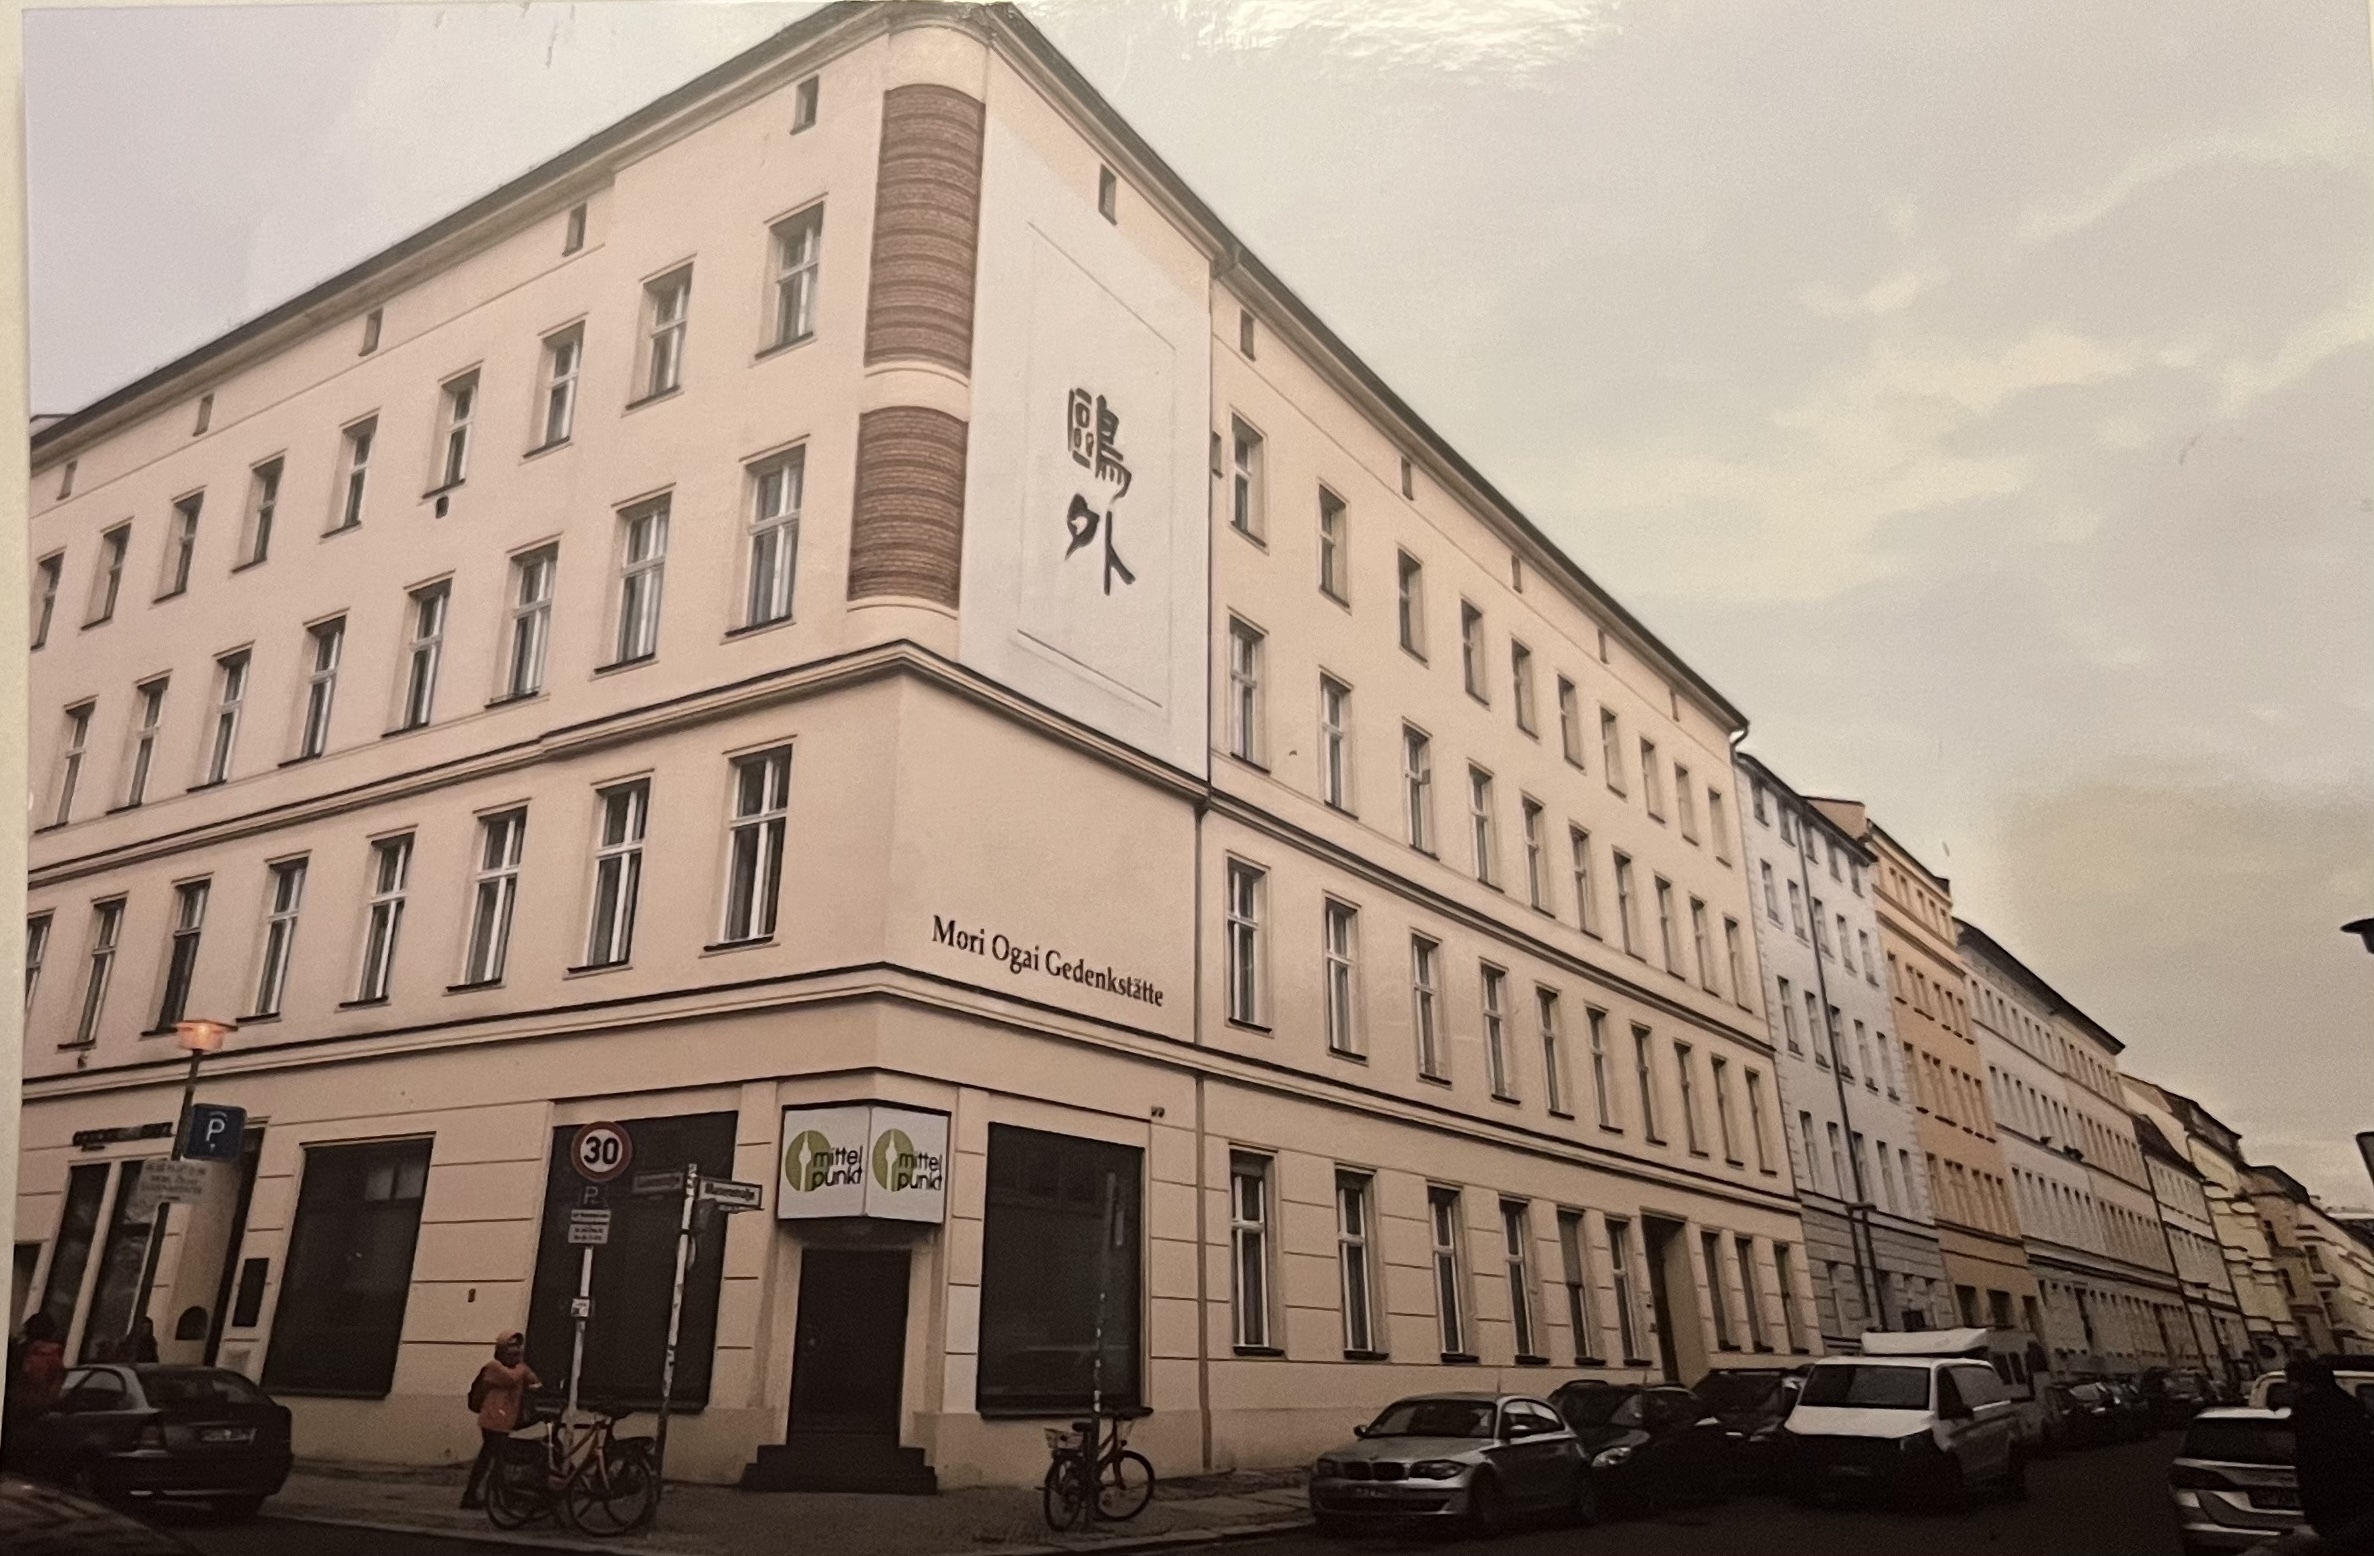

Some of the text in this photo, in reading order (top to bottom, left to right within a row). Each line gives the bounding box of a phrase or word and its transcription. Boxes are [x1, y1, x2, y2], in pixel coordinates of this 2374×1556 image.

[932, 914, 1164, 1008] Mori Ogai Gedenkstätte
[205, 1118, 225, 1142] P
[583, 1136, 620, 1165] 30
[813, 1145, 864, 1168] mittel
[899, 1152, 943, 1171] mittel
[811, 1165, 863, 1191] punkt
[897, 1172, 943, 1191] punkt
